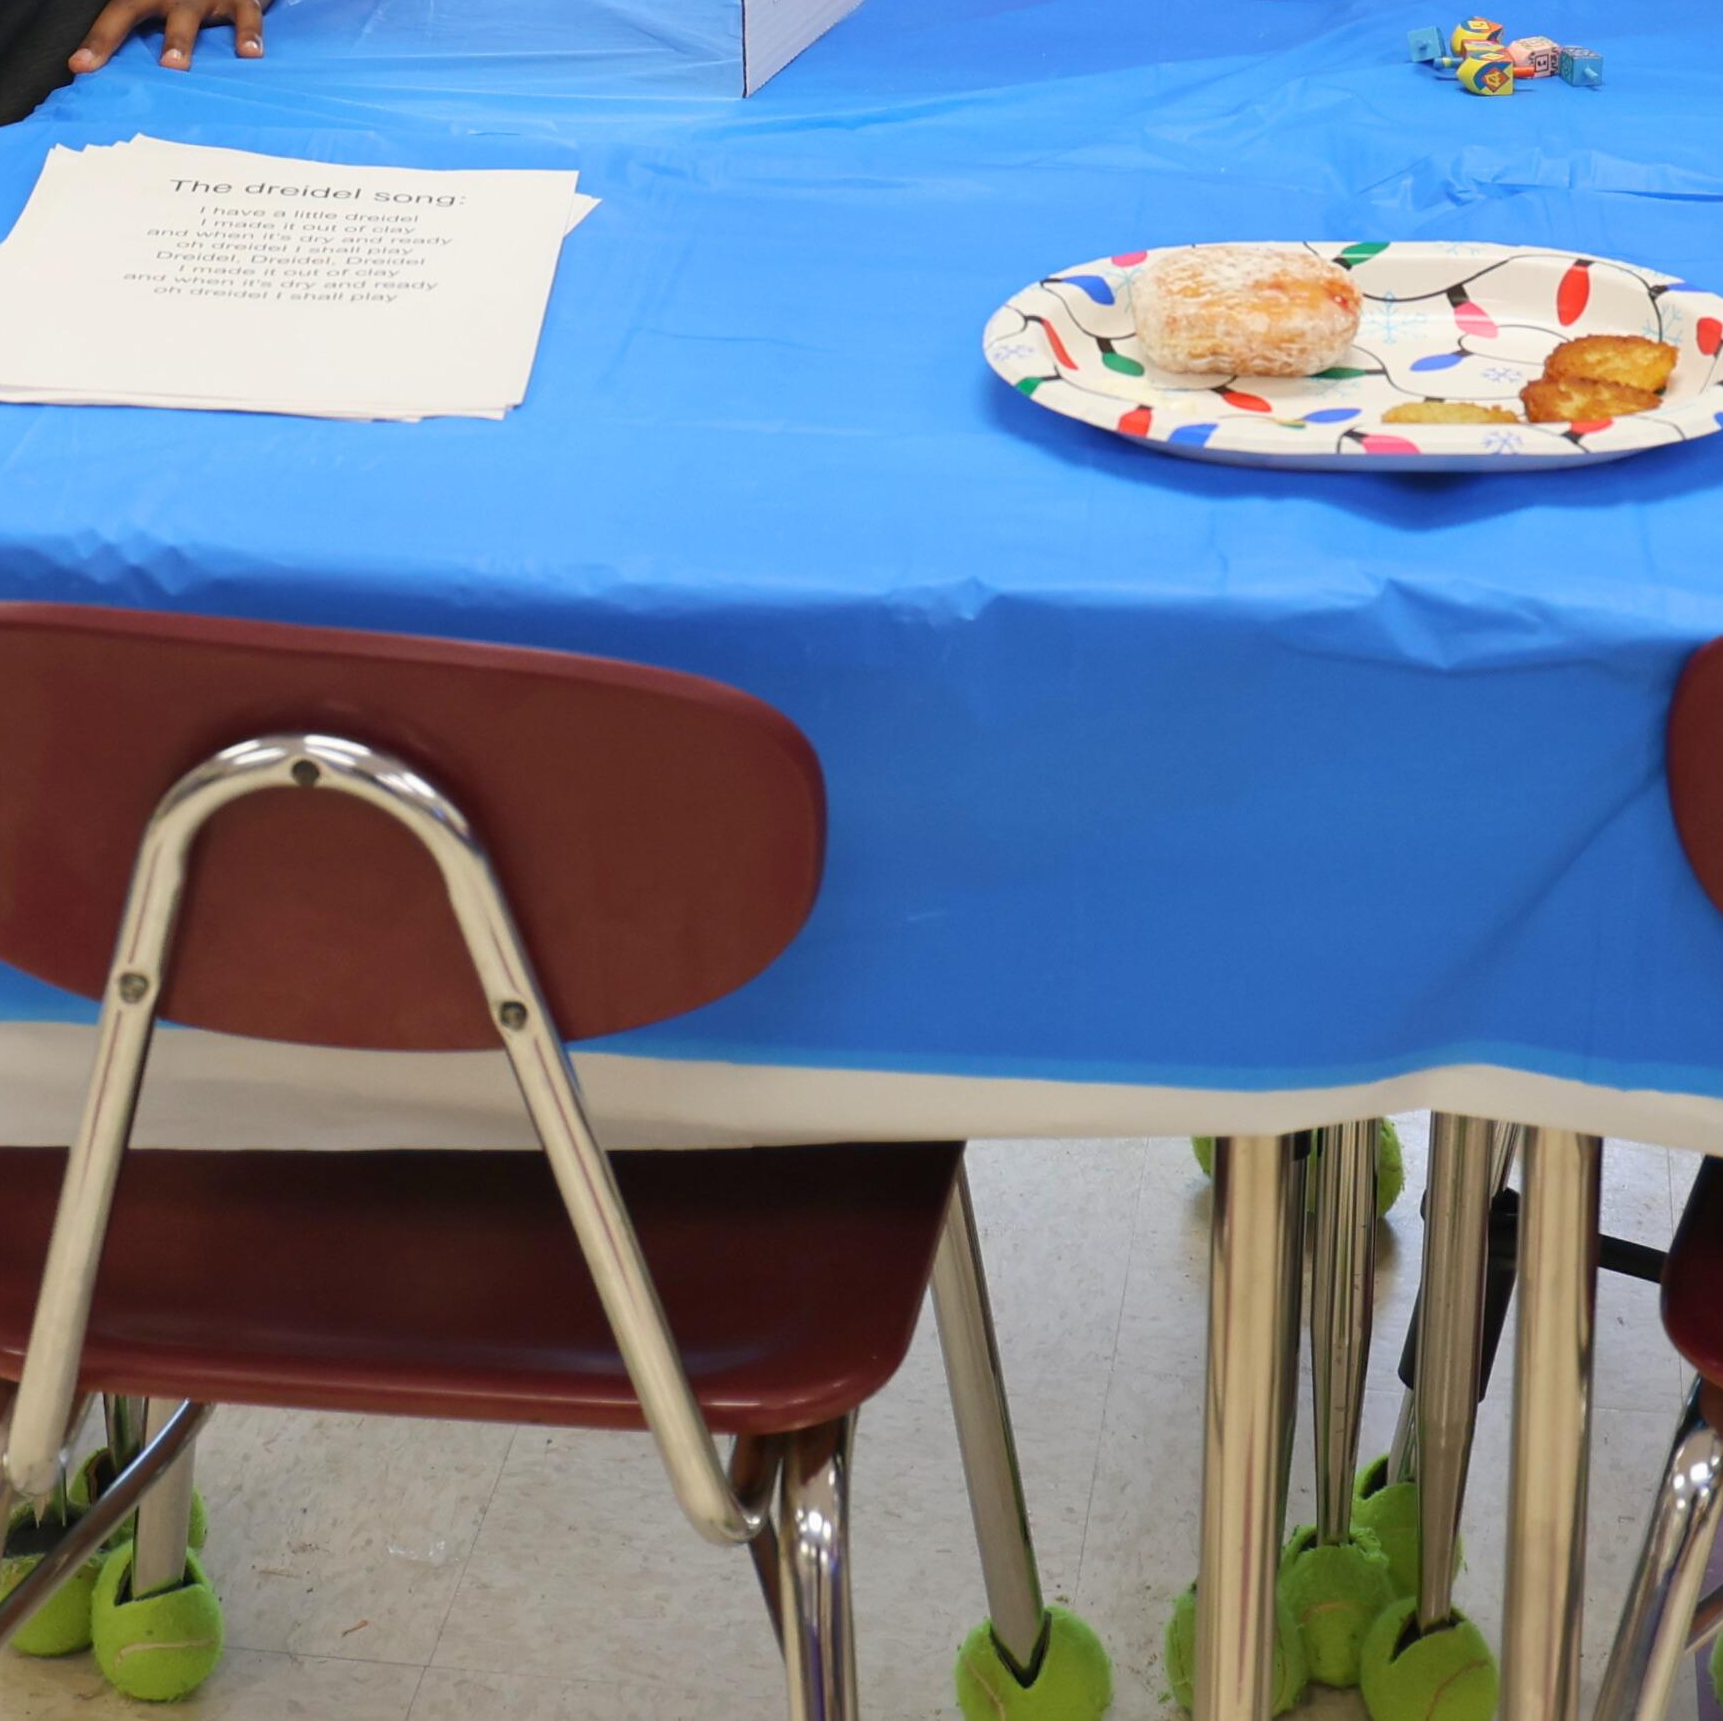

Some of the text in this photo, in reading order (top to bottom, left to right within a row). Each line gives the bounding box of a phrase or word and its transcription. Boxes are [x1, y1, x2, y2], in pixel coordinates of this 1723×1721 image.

[170, 179, 465, 208] The dreidel song:
[213, 206, 266, 217] have
[273, 209, 286, 218] a
[294, 210, 338, 220] little
[344, 213, 419, 223] dreidel
[214, 221, 275, 230] made
[283, 222, 294, 231] it
[302, 224, 337, 232] out
[344, 225, 368, 233] of
[372, 226, 416, 235] clay
[147, 229, 453, 246] and when it's dry and ready
[211, 241, 287, 252] dreidel
[309, 246, 360, 254] shall
[367, 246, 414, 255] play
[347, 256, 426, 265] Dreidel
[192, 267, 255, 275] made
[264, 268, 277, 276] it
[284, 269, 319, 277] out
[326, 269, 349, 277] of
[355, 268, 400, 278] clay
[123, 273, 438, 291] and when it's dry and ready
[153, 286, 181, 294] oh
[190, 288, 268, 299] dreidel
[290, 293, 343, 301] shall
[350, 294, 398, 303] play
